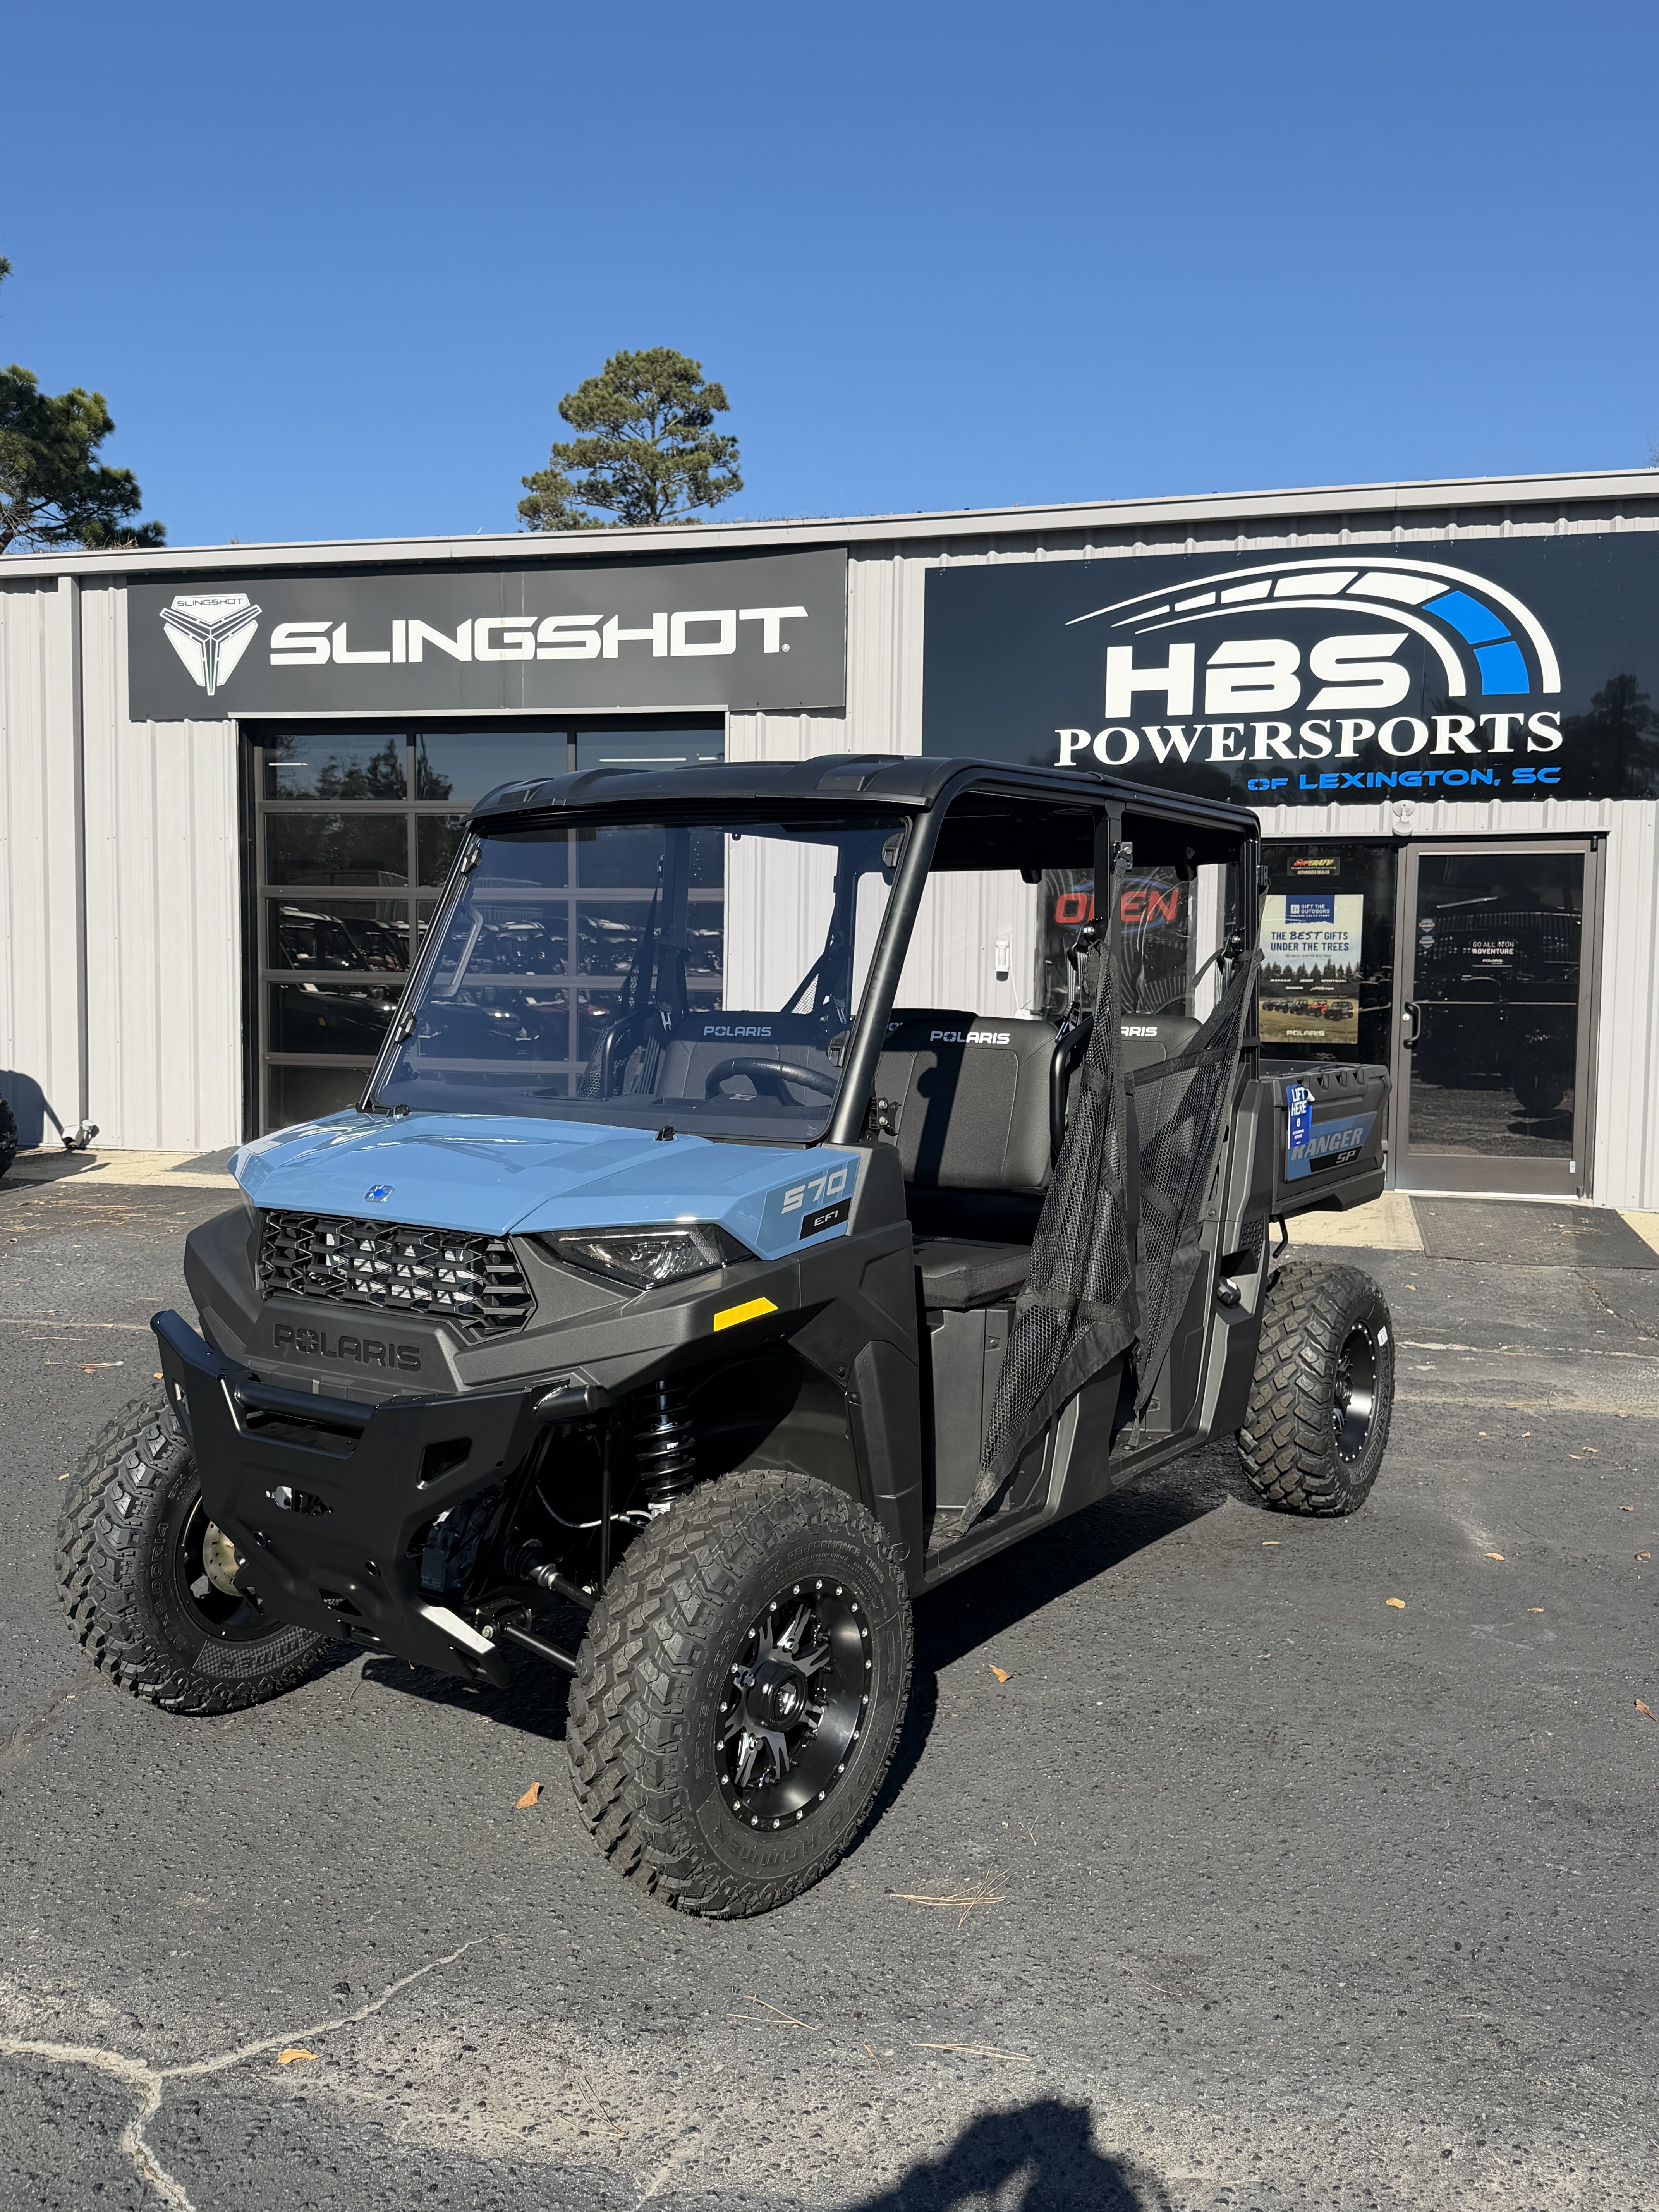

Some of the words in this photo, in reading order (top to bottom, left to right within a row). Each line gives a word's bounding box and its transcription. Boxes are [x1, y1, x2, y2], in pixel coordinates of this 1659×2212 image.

[270, 606, 809, 665] SLINGSHOT
[1105, 633, 1410, 718] HBS
[1054, 712, 1563, 767] POWERSPORTS
[1247, 778, 1288, 791] OF
[1299, 769, 1501, 790] LEXINGTON,
[1512, 767, 1561, 784] SC
[1271, 932, 1286, 940] THE
[1289, 931, 1323, 940] BEST
[1324, 932, 1348, 940] GIFTS
[1271, 943, 1298, 951] UNDER
[1302, 943, 1318, 951] THE
[1322, 943, 1349, 951] TREES
[704, 1026, 771, 1037] POLARIS
[930, 1031, 1010, 1044] POLARIS
[1291, 1087, 1306, 1102] LIFT
[1291, 1100, 1307, 1116] HERE
[1291, 1127, 1364, 1161] RANGER
[1336, 1150, 1357, 1163] SP
[781, 1168, 848, 1214] 570
[814, 1210, 838, 1226] EFI
[273, 1323, 421, 1372] POLARIS
[788, 1540, 862, 1561] PERFORMANCE
[865, 1555, 885, 1584] TIRES
